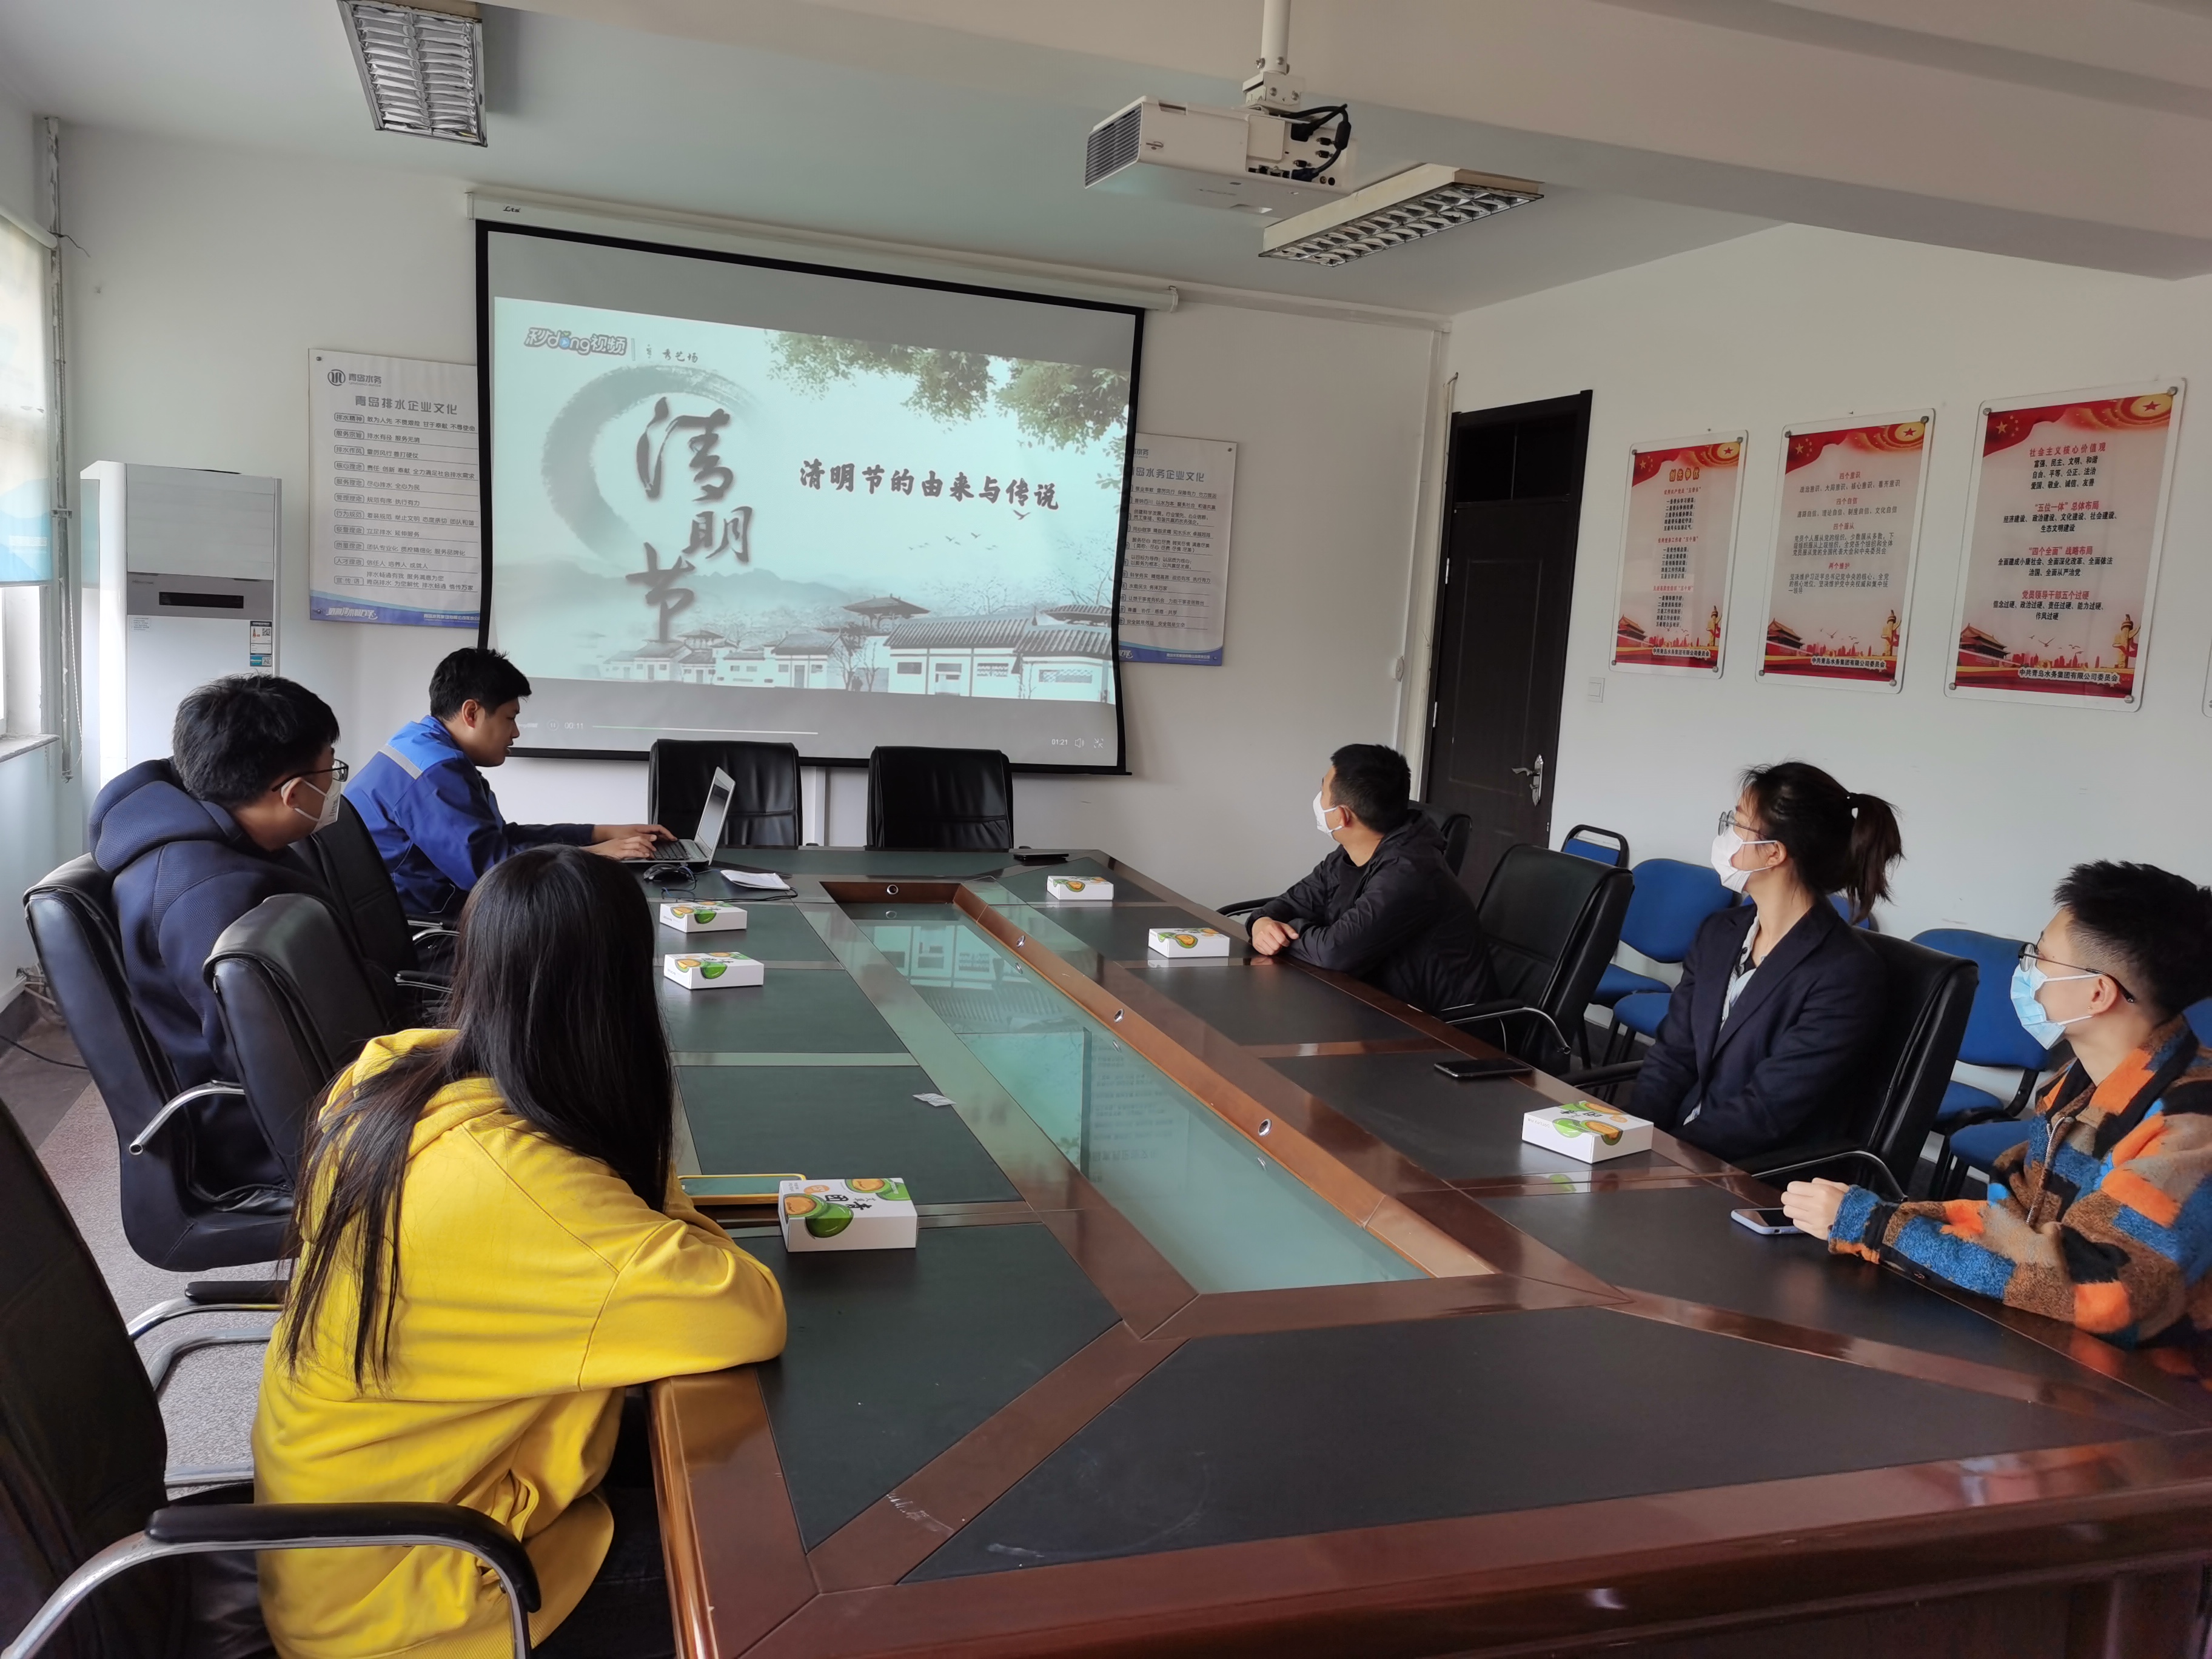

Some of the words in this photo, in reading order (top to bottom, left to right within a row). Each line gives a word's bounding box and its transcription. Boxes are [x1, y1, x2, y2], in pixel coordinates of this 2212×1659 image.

[355, 395, 457, 415] 青岛排水企业文化
[336, 414, 363, 423] 排水精神
[367, 416, 392, 424] 敢为人先
[2029, 442, 2106, 457] 社会主义核心价值观
[2034, 455, 2098, 468] 富强、民主、文明、和谐
[413, 468, 475, 479] 全力满足社会排水需求
[1132, 467, 1204, 482] 岛水务企业文化
[1839, 471, 1861, 480] 四个意识
[2032, 468, 2096, 479] 自由、平等、公正、法治
[799, 457, 1059, 511] 清明节的由来与传说
[2030, 478, 2095, 490] 爱国、敬业、诚信、友善
[2003, 511, 2117, 523] 经济建设、政治建设、文化建设、社会建设、
[2040, 524, 2076, 533] 生态文明建设
[1997, 557, 2114, 566] 全面建成小康社会、全面深化改革、全面依法
[2028, 568, 2081, 577] 治国、全面从严治党
[2022, 589, 2090, 601] 党员领导干部五个过硬
[2036, 612, 2059, 621] 作风过硬
[1653, 648, 1709, 657] 中共青岛水务集团有限公司委员会
[1812, 657, 1885, 668] 中共青岛水务集团有限公司委员会
[2019, 669, 2118, 682] 中共青岛水务集团有限公司委员会
